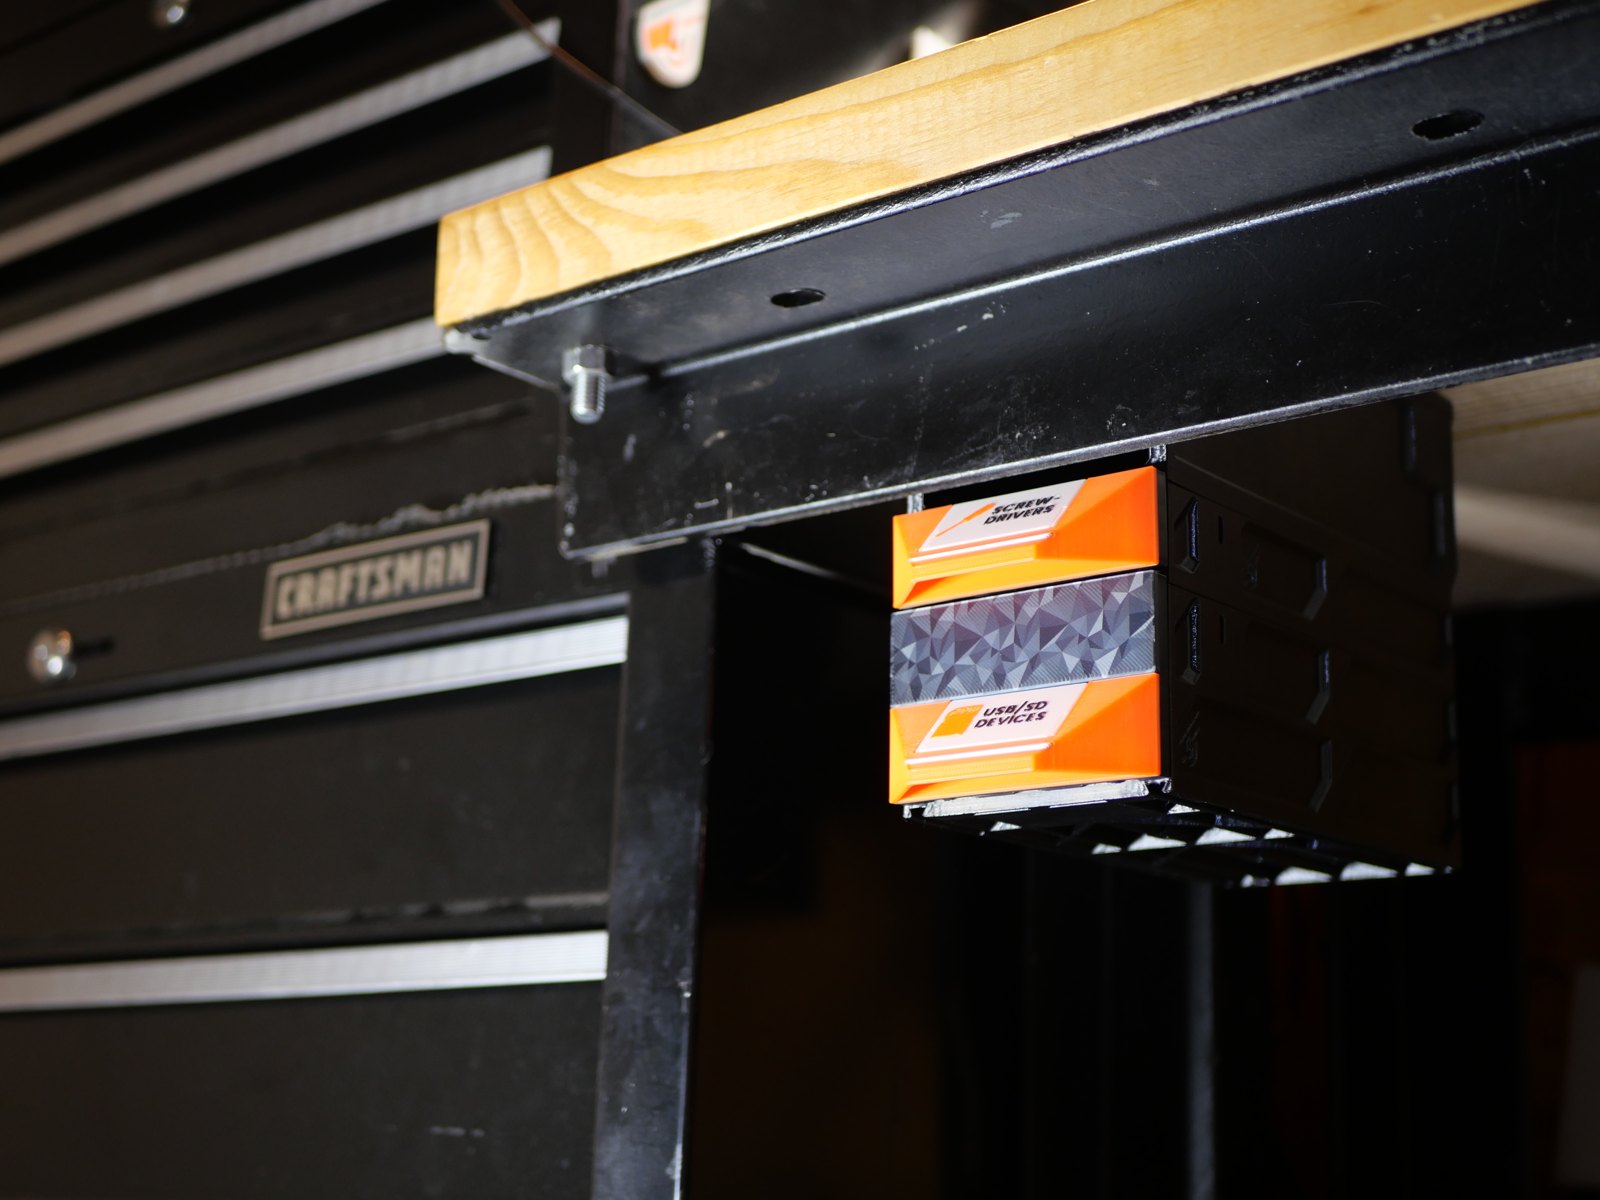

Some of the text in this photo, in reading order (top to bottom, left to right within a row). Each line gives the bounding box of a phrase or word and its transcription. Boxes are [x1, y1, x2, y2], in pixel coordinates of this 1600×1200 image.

[992, 496, 1061, 514] SCREW-
[984, 505, 1055, 525] DRIVERS
[276, 540, 472, 619] CRAFTSMAN
[983, 701, 1048, 716] USB/SD
[974, 711, 1046, 728] DEVICES
